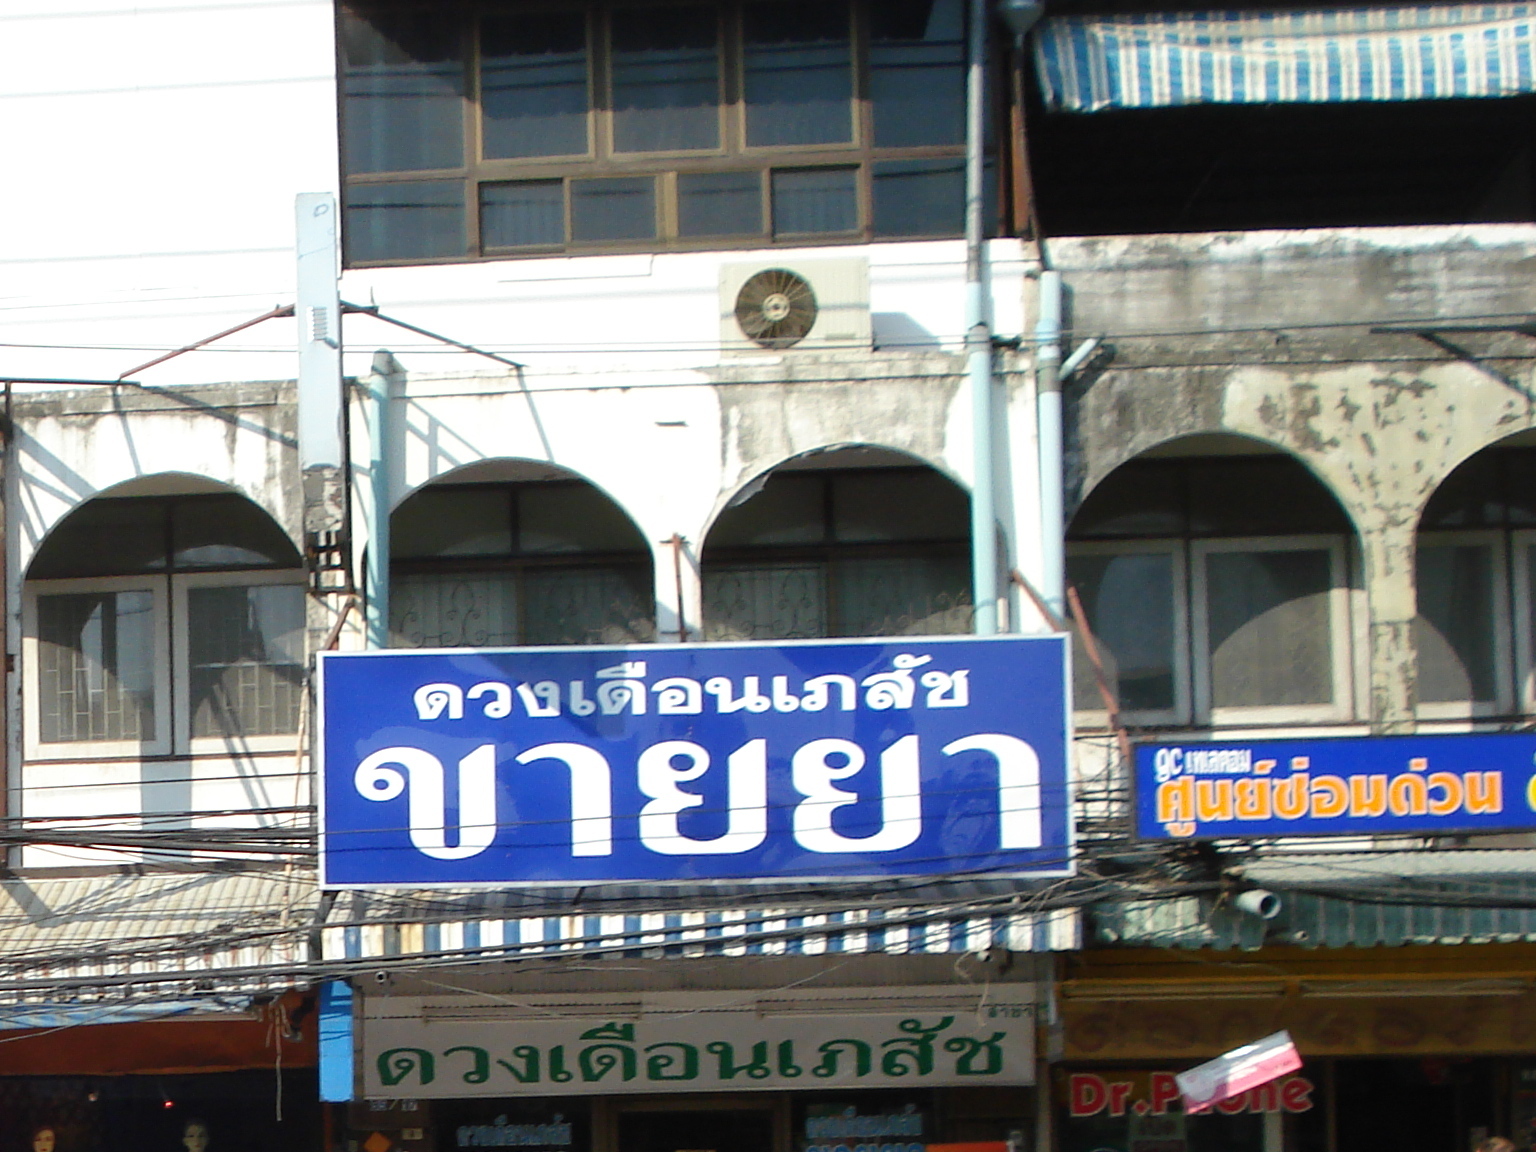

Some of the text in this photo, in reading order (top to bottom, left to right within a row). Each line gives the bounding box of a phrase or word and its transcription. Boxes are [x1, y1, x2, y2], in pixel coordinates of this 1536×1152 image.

[414, 653, 969, 720] ดวงเดือนเภสัช
[354, 733, 1043, 861] ขายยา
[1156, 757, 1502, 837] ศูนย์ซ่อมด่วน
[375, 1016, 1007, 1088] ดวงเดือนเภสัช
[1070, 1072, 1314, 1117] Dr.Pne
